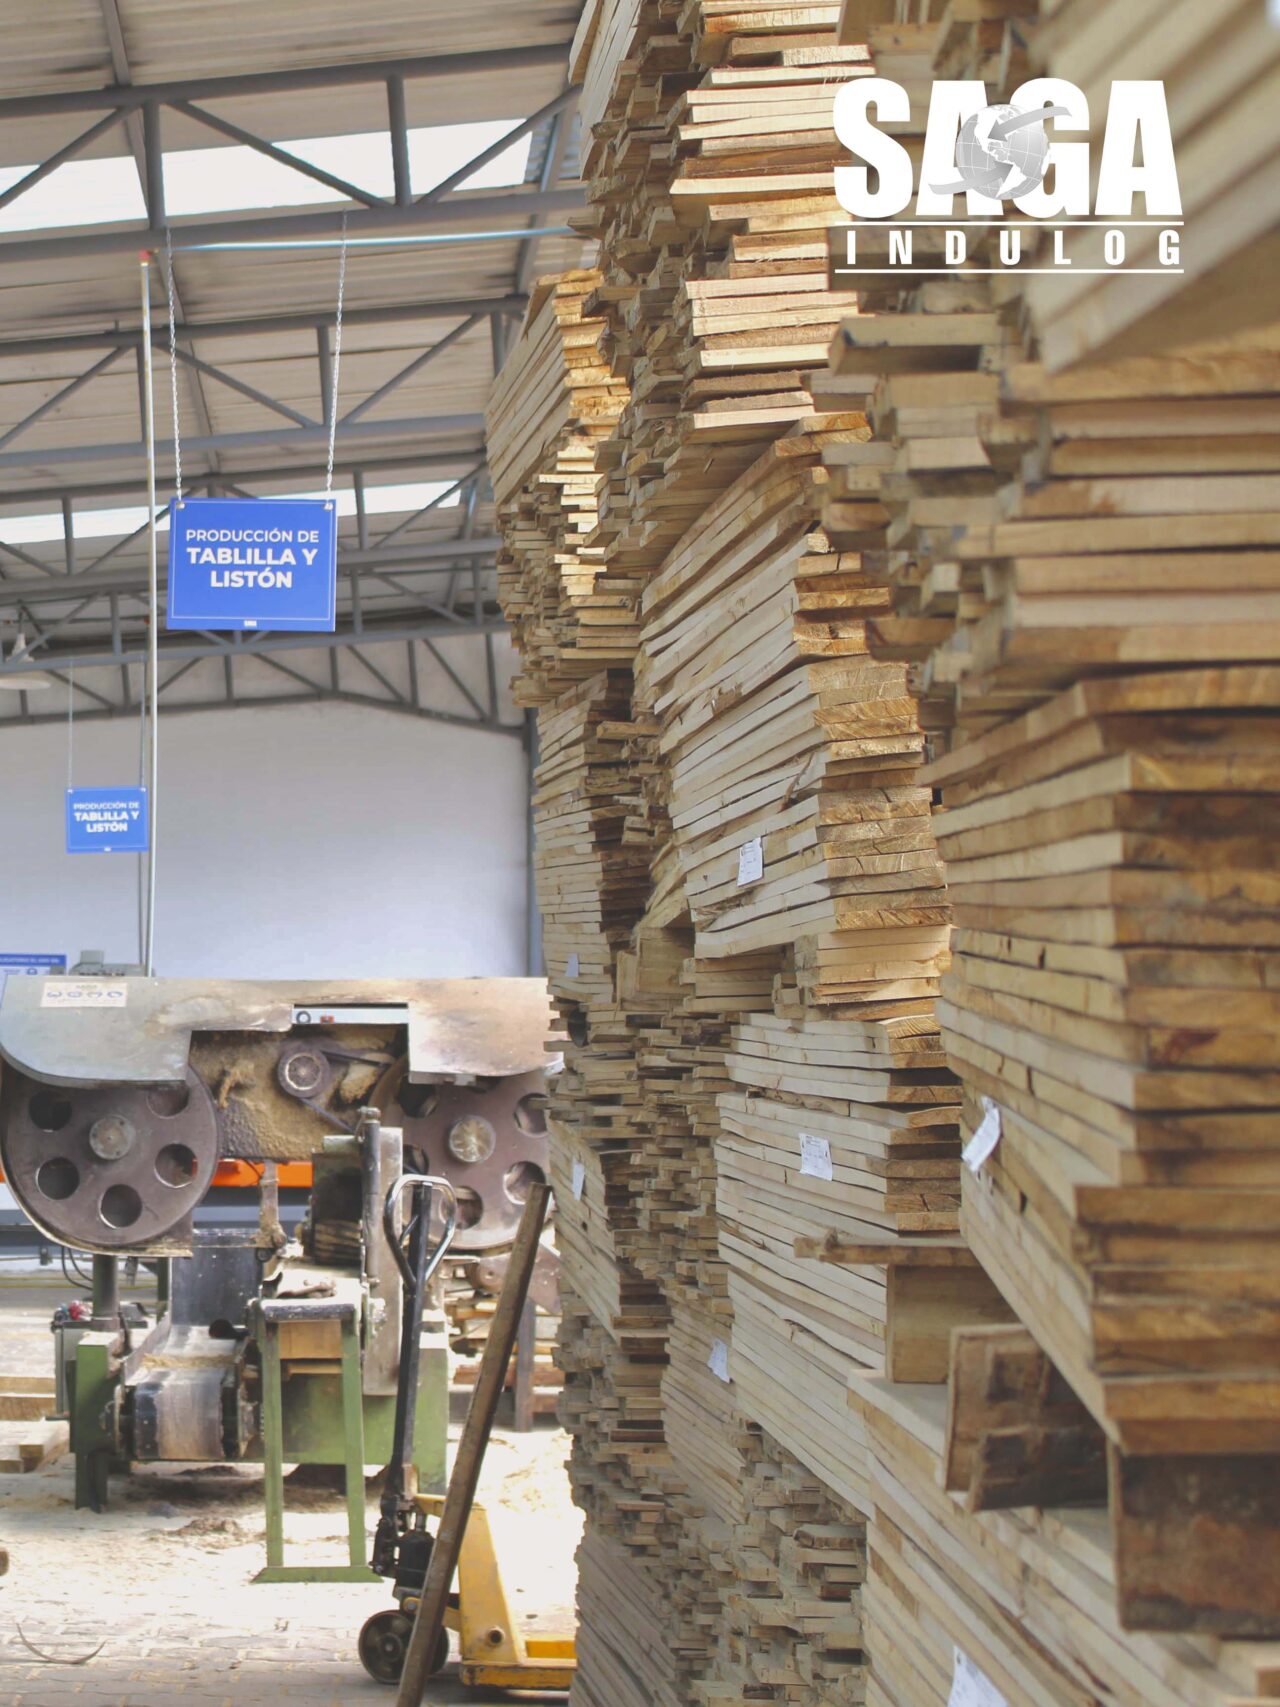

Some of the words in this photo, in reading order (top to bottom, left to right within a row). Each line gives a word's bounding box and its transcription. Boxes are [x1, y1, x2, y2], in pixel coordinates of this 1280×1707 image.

[185, 527, 293, 543] PRODUCCIÓN
[297, 530, 320, 543] DE
[186, 547, 297, 565] TABLILLA
[302, 548, 318, 566] Y
[210, 567, 293, 588] LISTÓN
[74, 810, 129, 822] TABLILLA
[131, 810, 140, 820] Y
[86, 821, 128, 833] LISTÓN
